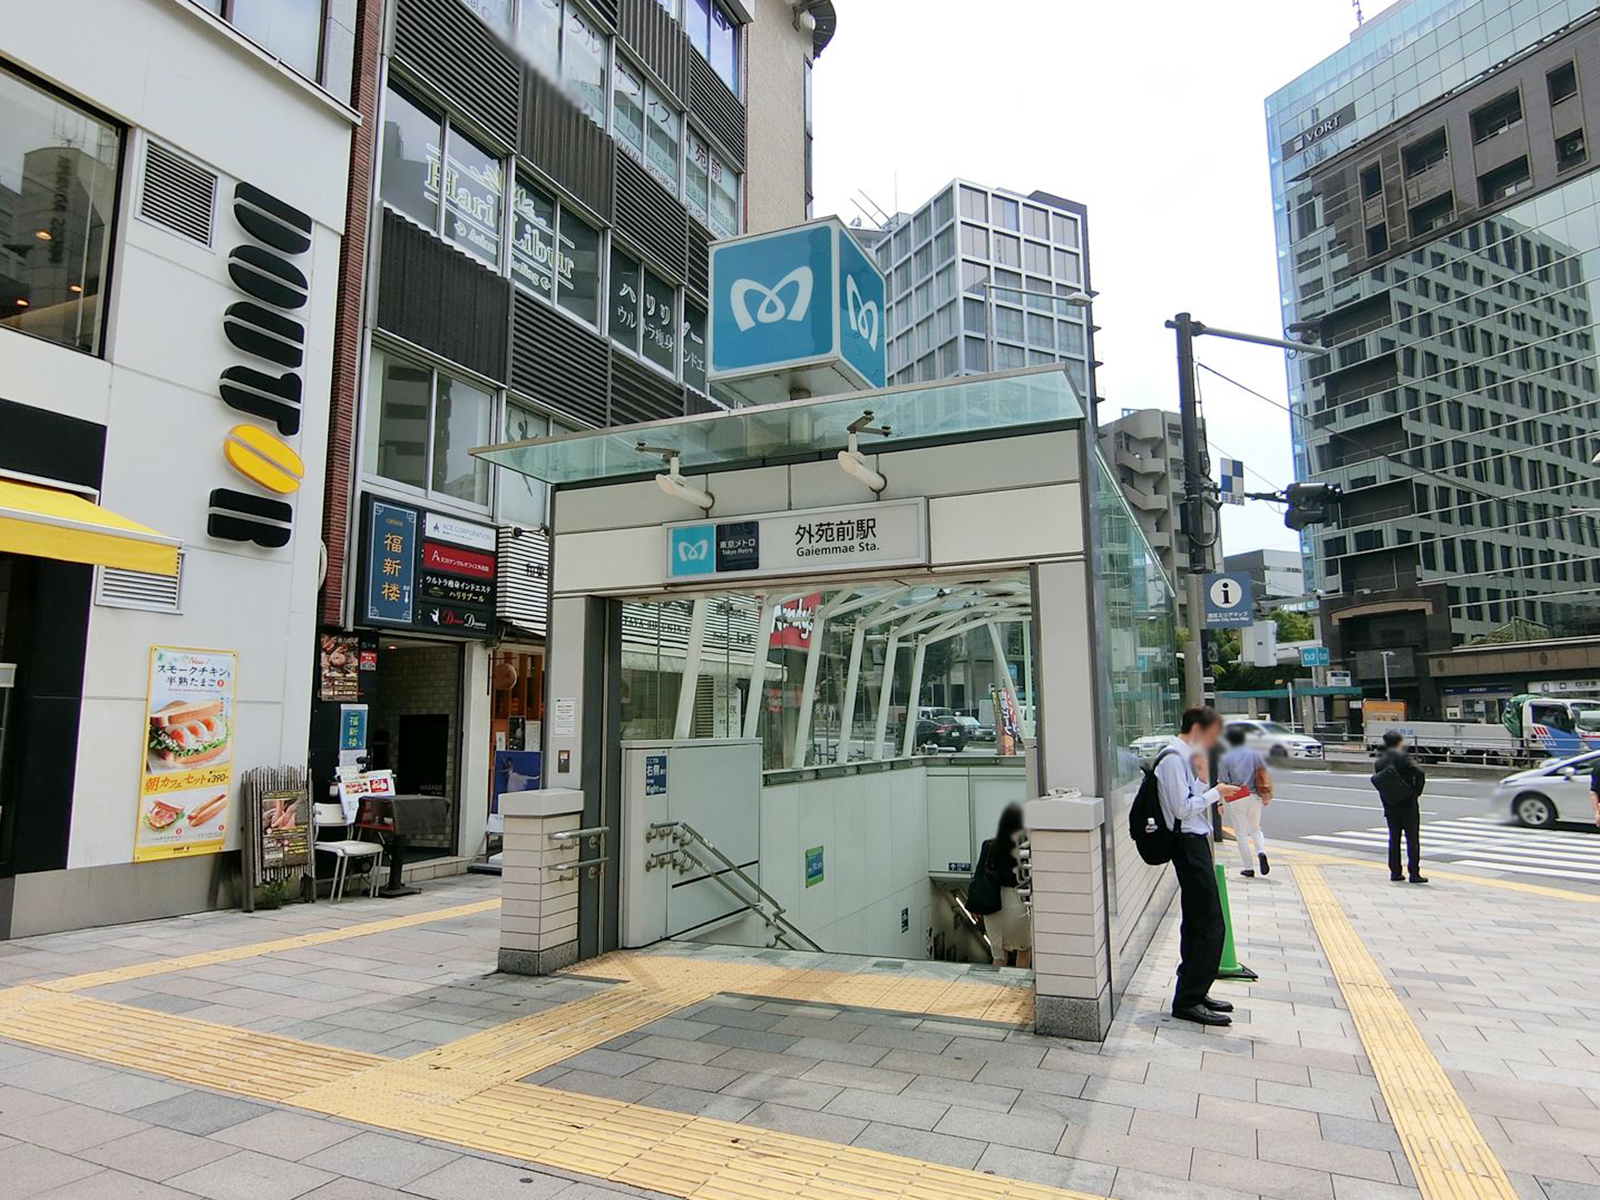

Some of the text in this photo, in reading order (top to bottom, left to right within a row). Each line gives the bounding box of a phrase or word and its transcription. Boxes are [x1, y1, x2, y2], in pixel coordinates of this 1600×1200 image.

[1305, 114, 1341, 143] VORT
[424, 154, 575, 280] Hari Libur
[511, 255, 540, 287] ealing
[617, 305, 706, 373] ウルトラ痩身ンドエ
[443, 523, 454, 532] ACE
[795, 518, 877, 545] 外苑前駅
[720, 538, 755, 550] 東京メトロ
[796, 541, 880, 558] Gaiemmae Sta.
[381, 532, 404, 602] 福新楼
[157, 664, 232, 679] スモークチキンと
[166, 676, 216, 687] 半熟たまご
